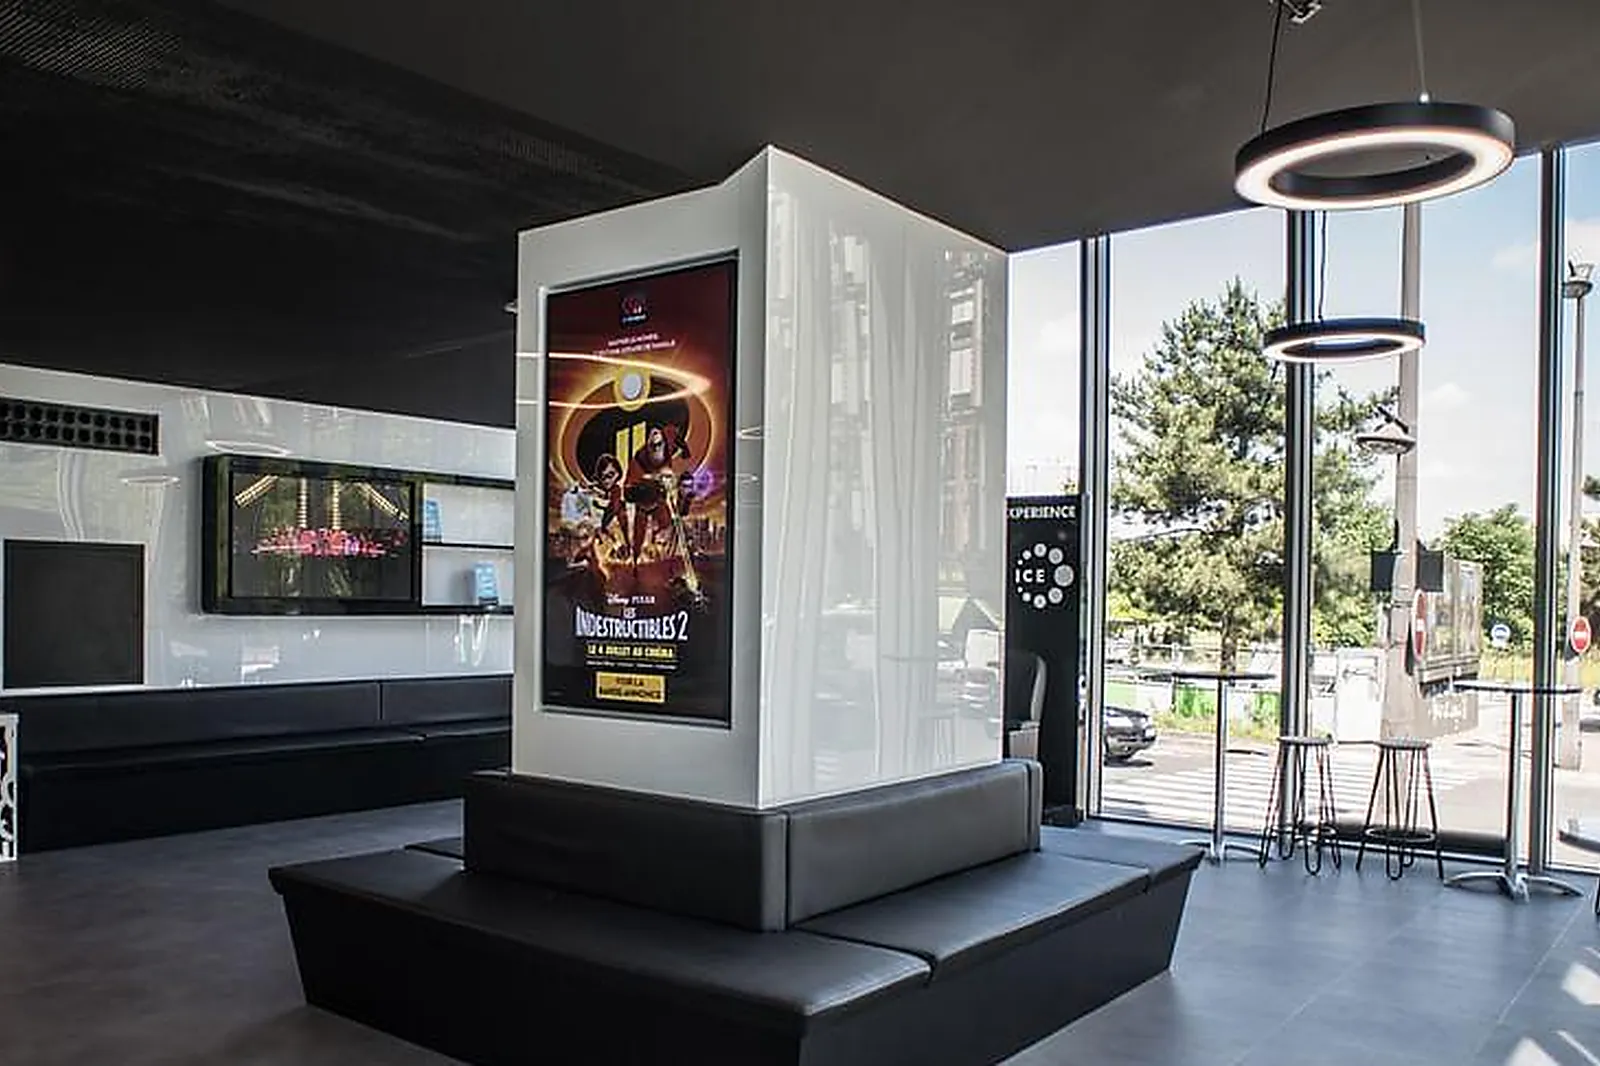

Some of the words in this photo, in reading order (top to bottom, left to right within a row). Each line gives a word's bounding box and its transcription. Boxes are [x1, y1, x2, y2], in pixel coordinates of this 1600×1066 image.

[1008, 505, 1076, 519] XPERIENCE
[1015, 569, 1045, 583] ICE
[607, 594, 629, 605] Disney
[575, 606, 676, 640] INDESTRUCTIBLES
[677, 610, 688, 641] 2
